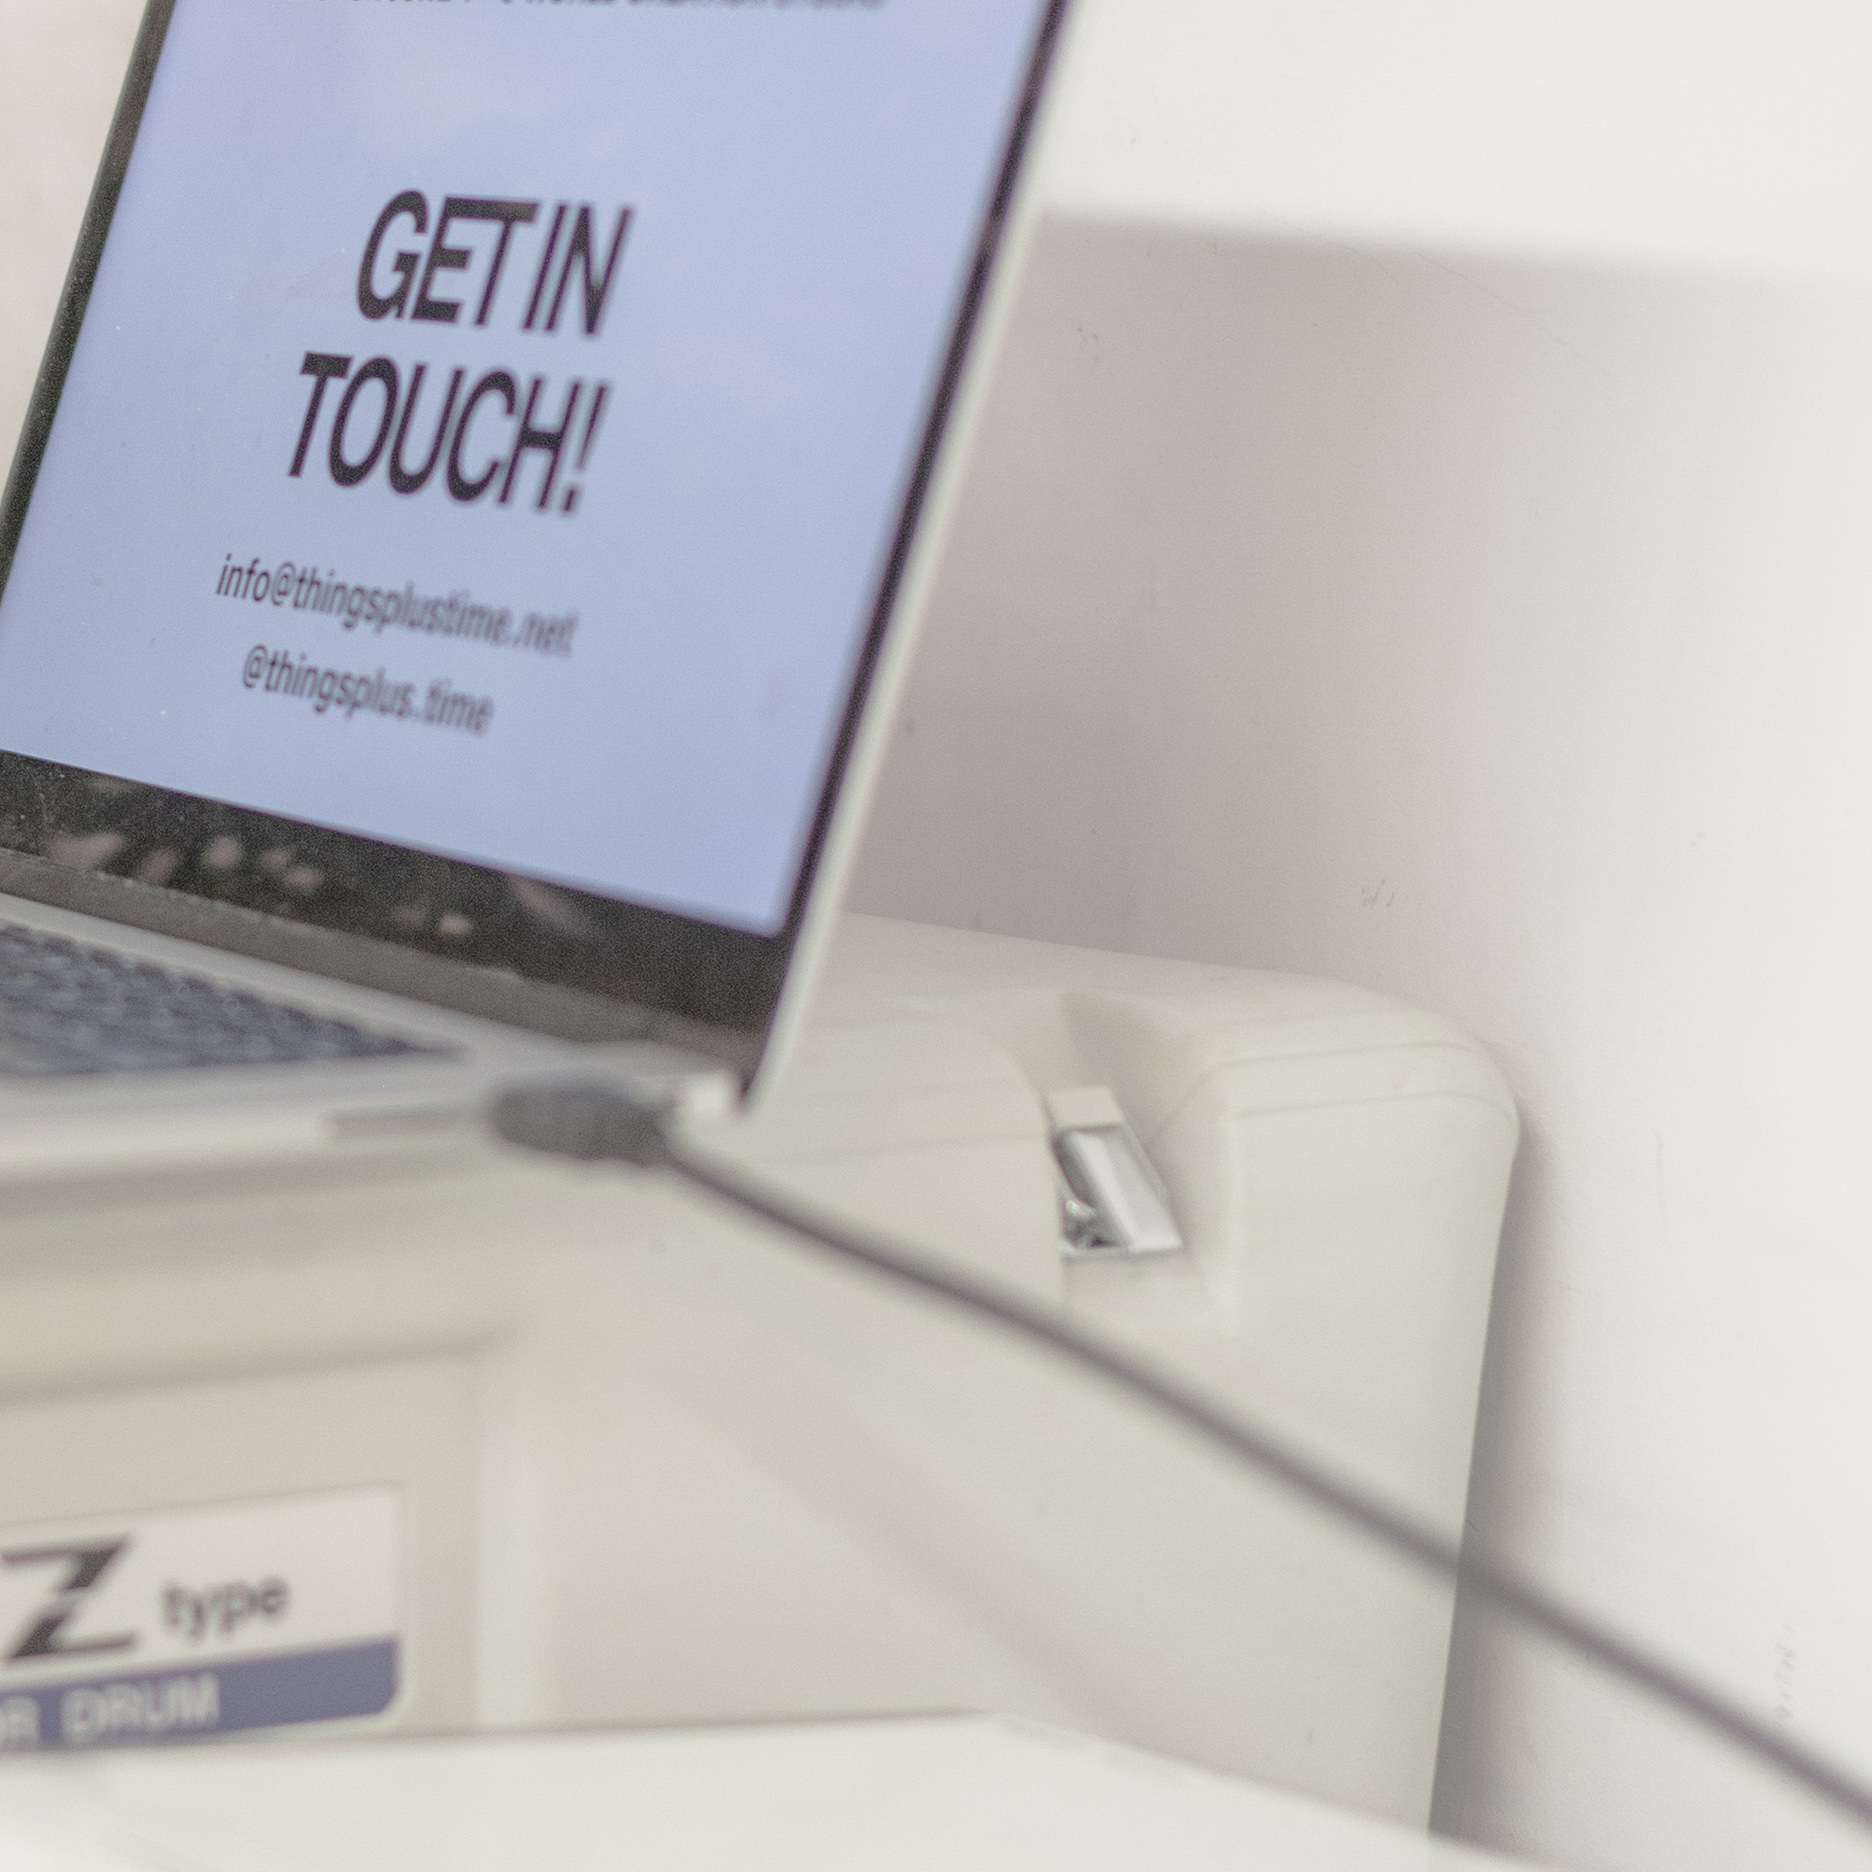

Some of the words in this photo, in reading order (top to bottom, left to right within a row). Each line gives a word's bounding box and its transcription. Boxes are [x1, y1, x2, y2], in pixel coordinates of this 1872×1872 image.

[356, 189, 540, 327] GET
[522, 201, 635, 336] IN
[288, 350, 610, 515] TOUCH!
[215, 552, 580, 659] info@thingsplustime.net
[241, 643, 495, 736] @thingsplus.time
[161, 1576, 289, 1641] type
[61, 1672, 220, 1744] DRUM
